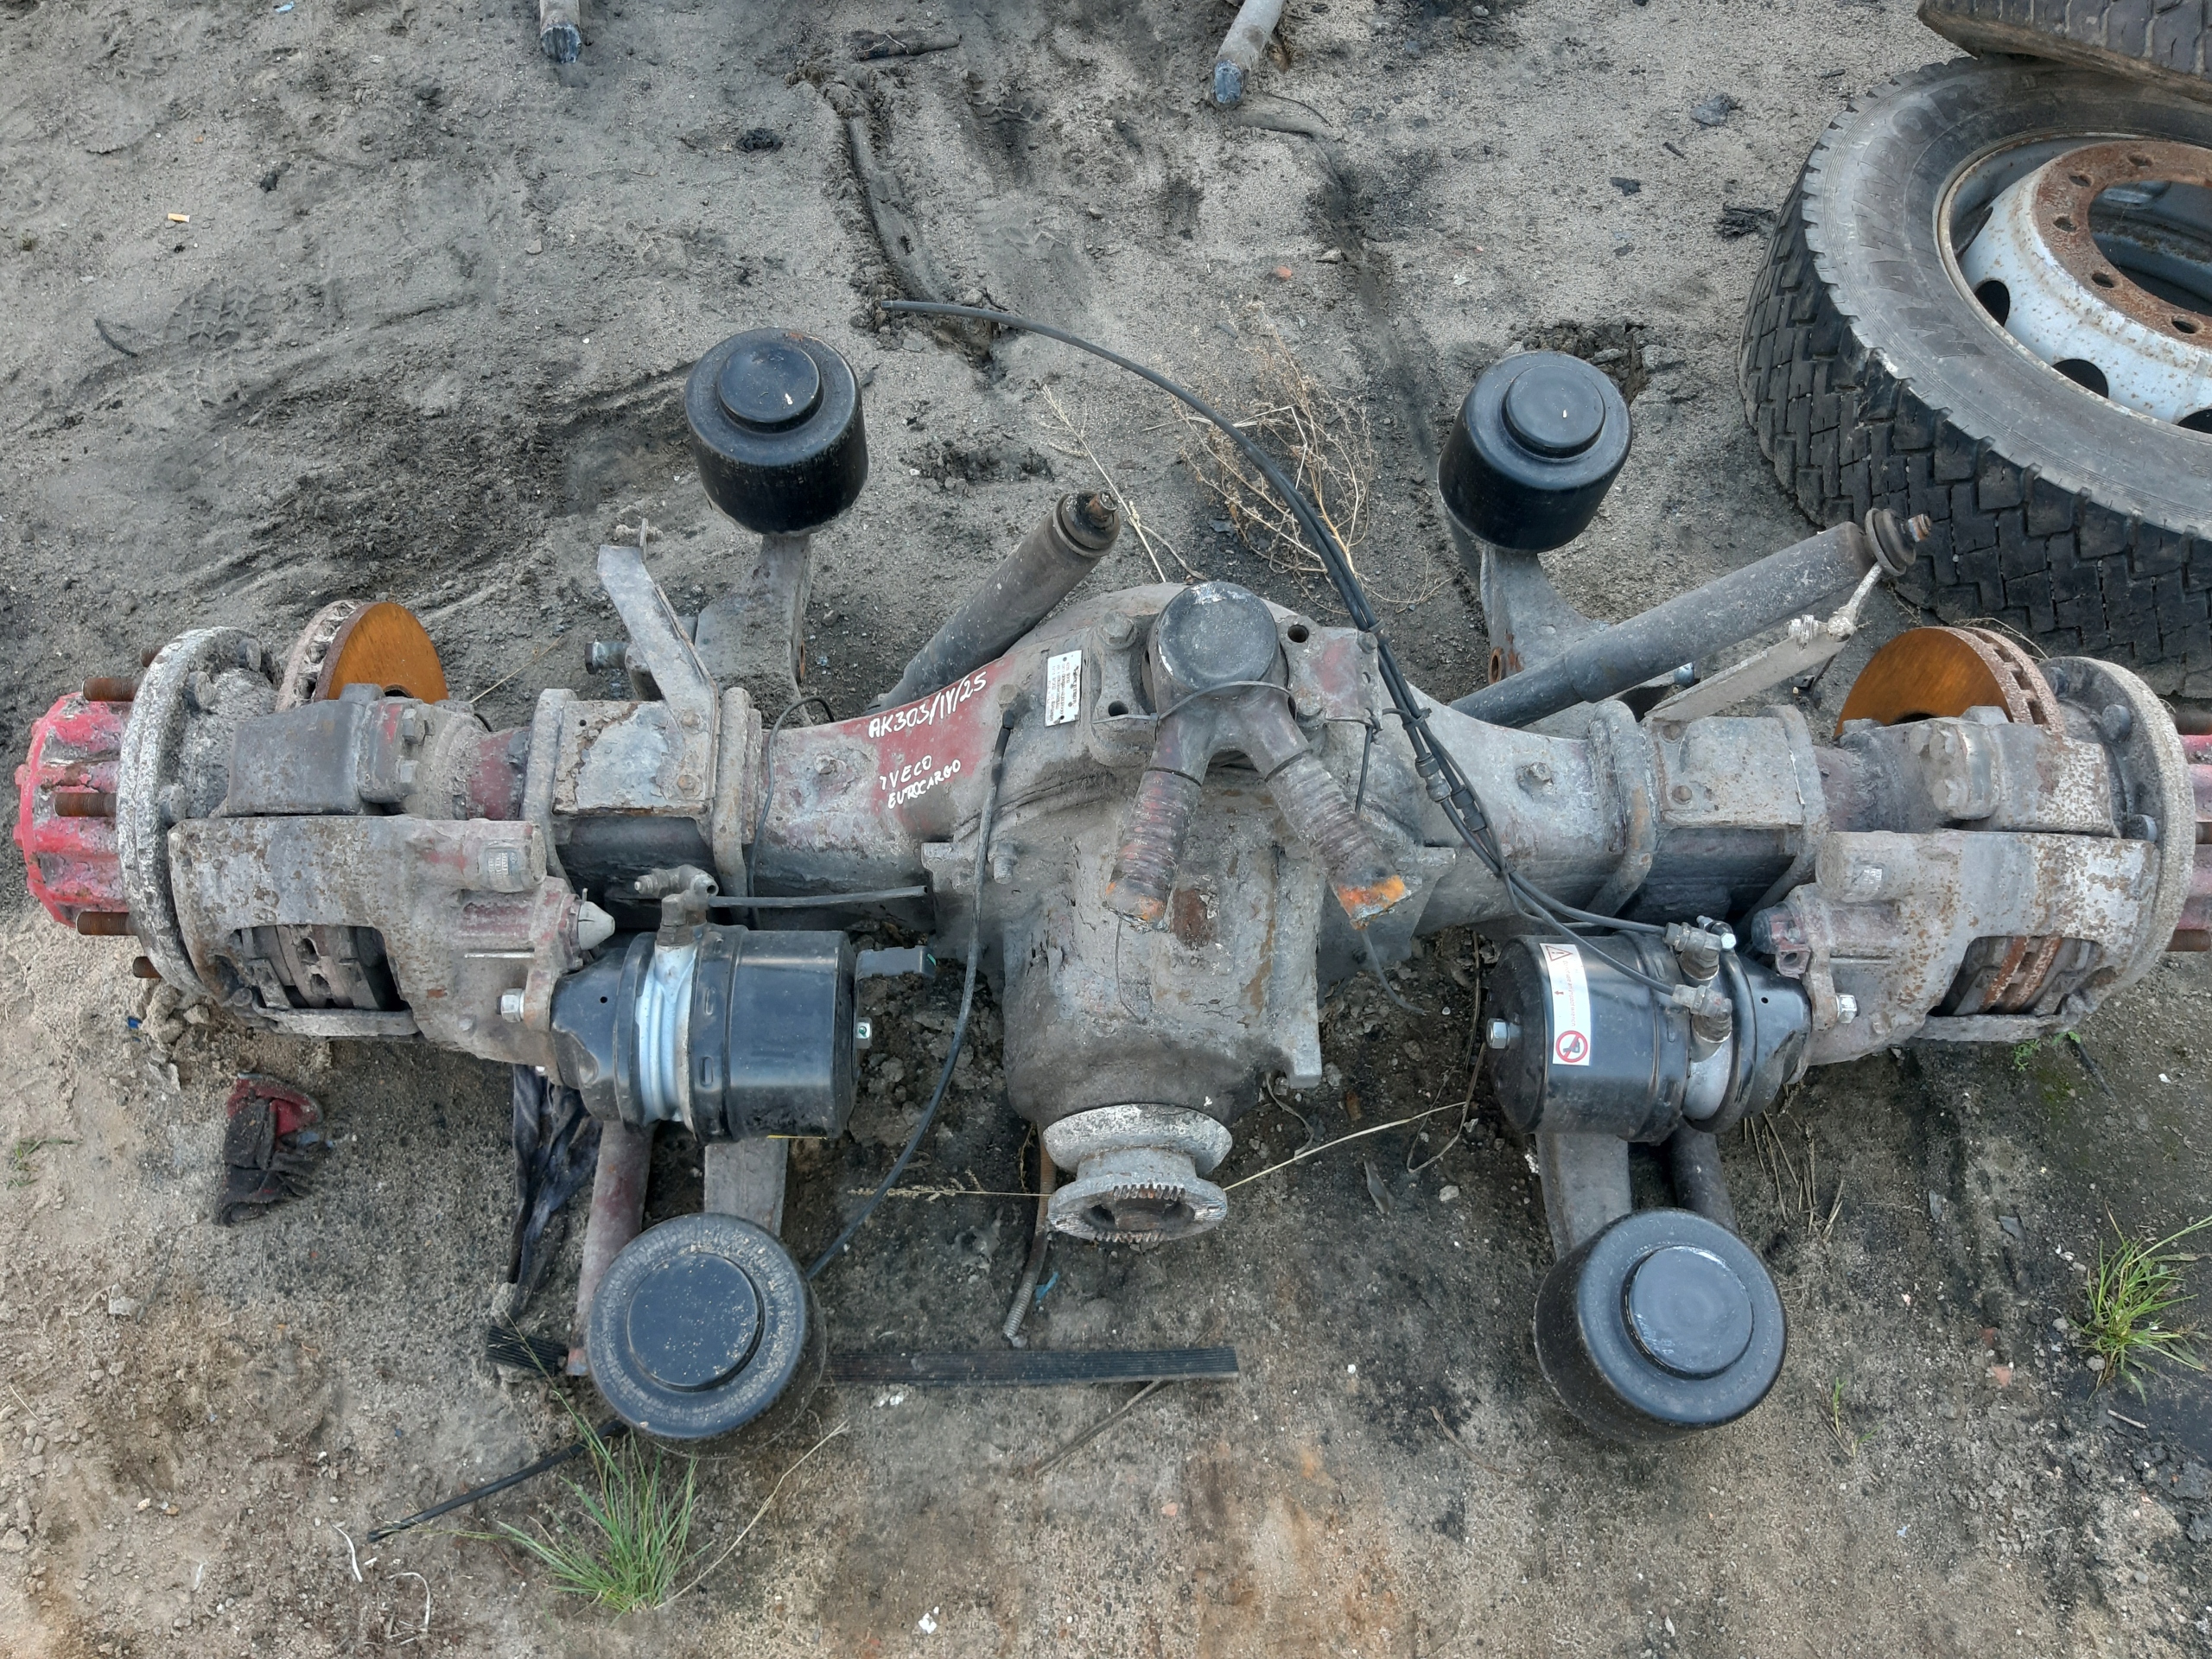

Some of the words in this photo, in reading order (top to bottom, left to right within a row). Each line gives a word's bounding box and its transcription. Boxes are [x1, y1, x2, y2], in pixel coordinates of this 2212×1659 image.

[1853, 83, 1987, 358] MATADOR
[880, 755, 931, 790] IVECO
[888, 760, 961, 809] EUROCARGO
